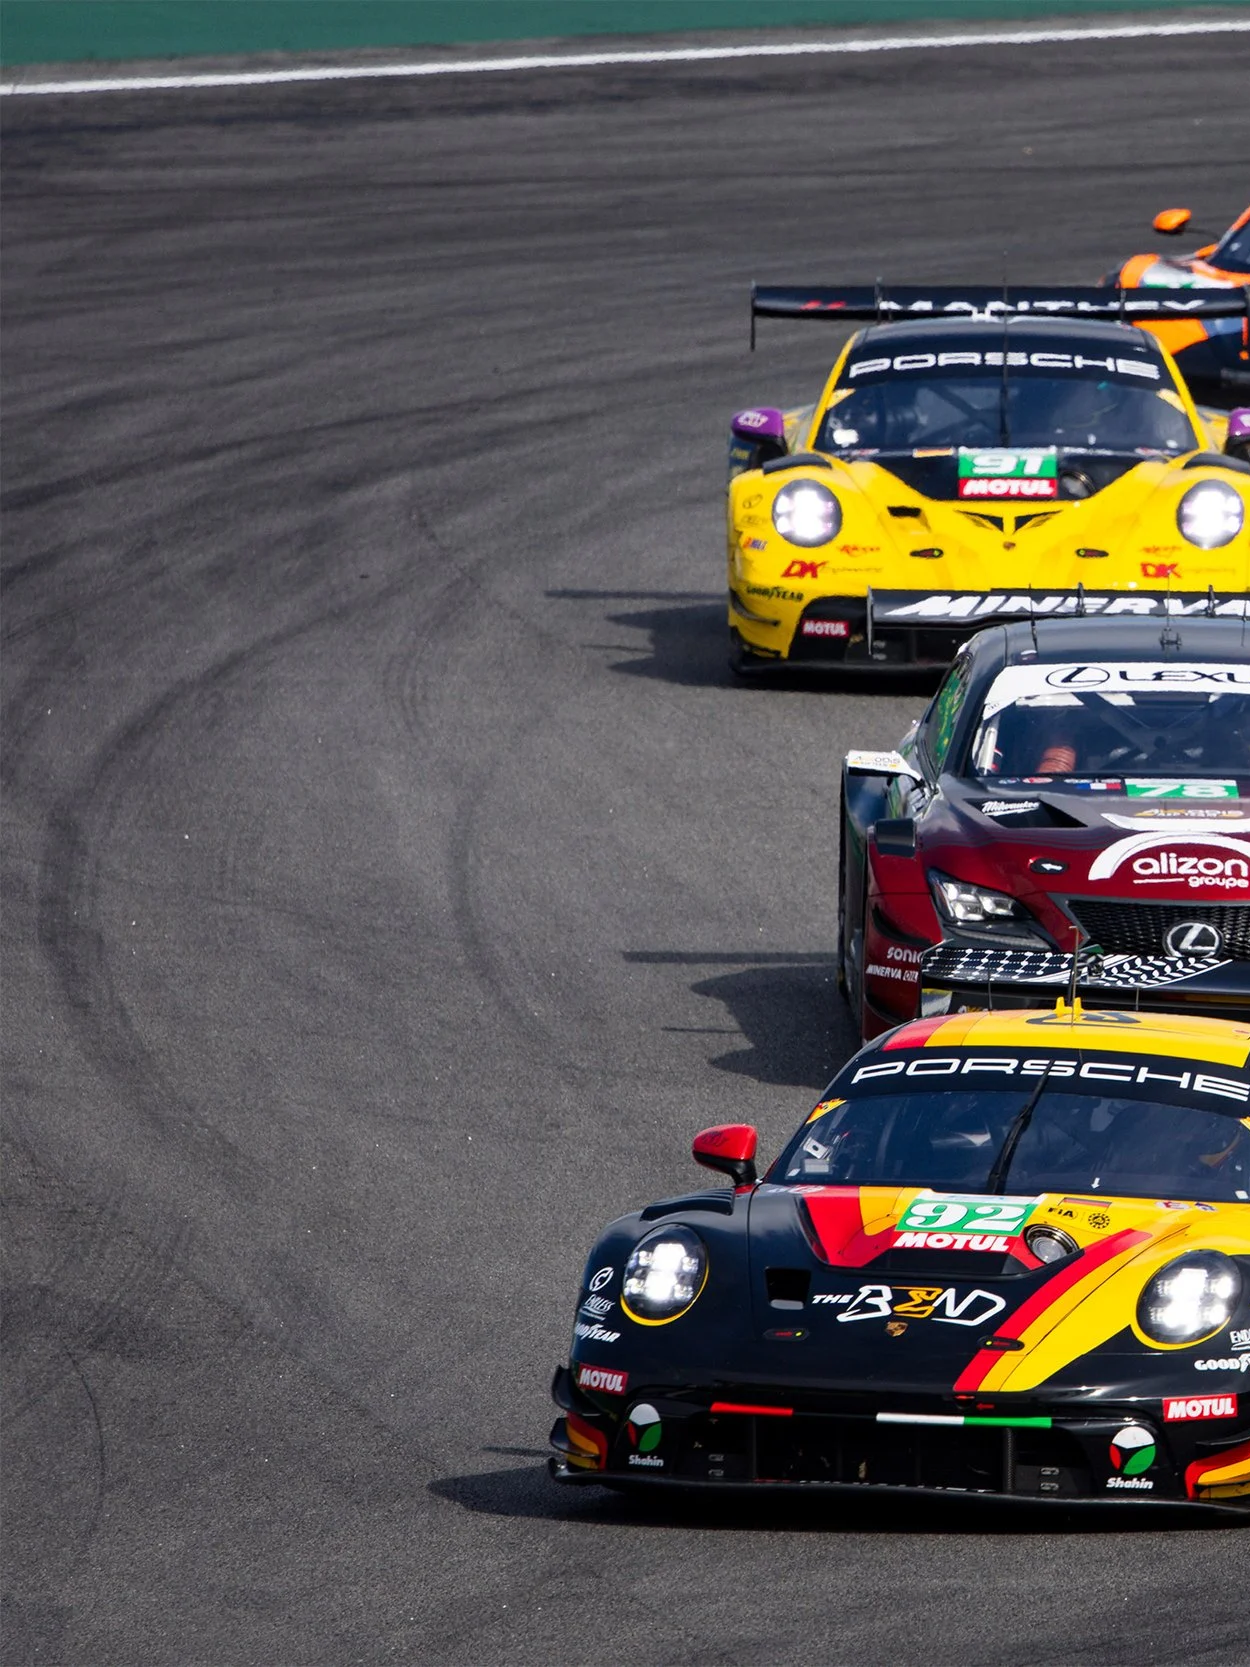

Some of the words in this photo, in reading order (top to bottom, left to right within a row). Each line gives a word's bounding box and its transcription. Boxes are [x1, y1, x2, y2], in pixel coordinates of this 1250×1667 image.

[848, 351, 1161, 380] PORSCHE
[972, 454, 1044, 475] 91
[963, 479, 1054, 495] MOTUL
[781, 559, 829, 579] DK
[1140, 562, 1182, 579] DK
[803, 620, 847, 636] MOTUL
[1135, 784, 1230, 798] 78
[980, 800, 1040, 813] Milwaukee
[1132, 852, 1249, 877] alizon
[1188, 876, 1249, 889] groupe
[866, 963, 902, 980] MINERVA
[851, 1057, 1250, 1102] PORSCHE
[904, 1202, 1027, 1233] 92
[1047, 1207, 1076, 1219] FIA
[893, 1230, 1009, 1252] MOTUL
[812, 1294, 852, 1305] THE
[579, 1368, 624, 1392] MOTUL
[1167, 1398, 1235, 1419] MOTUL
[628, 1454, 664, 1467] Shahin
[1106, 1477, 1154, 1490] Shahin
